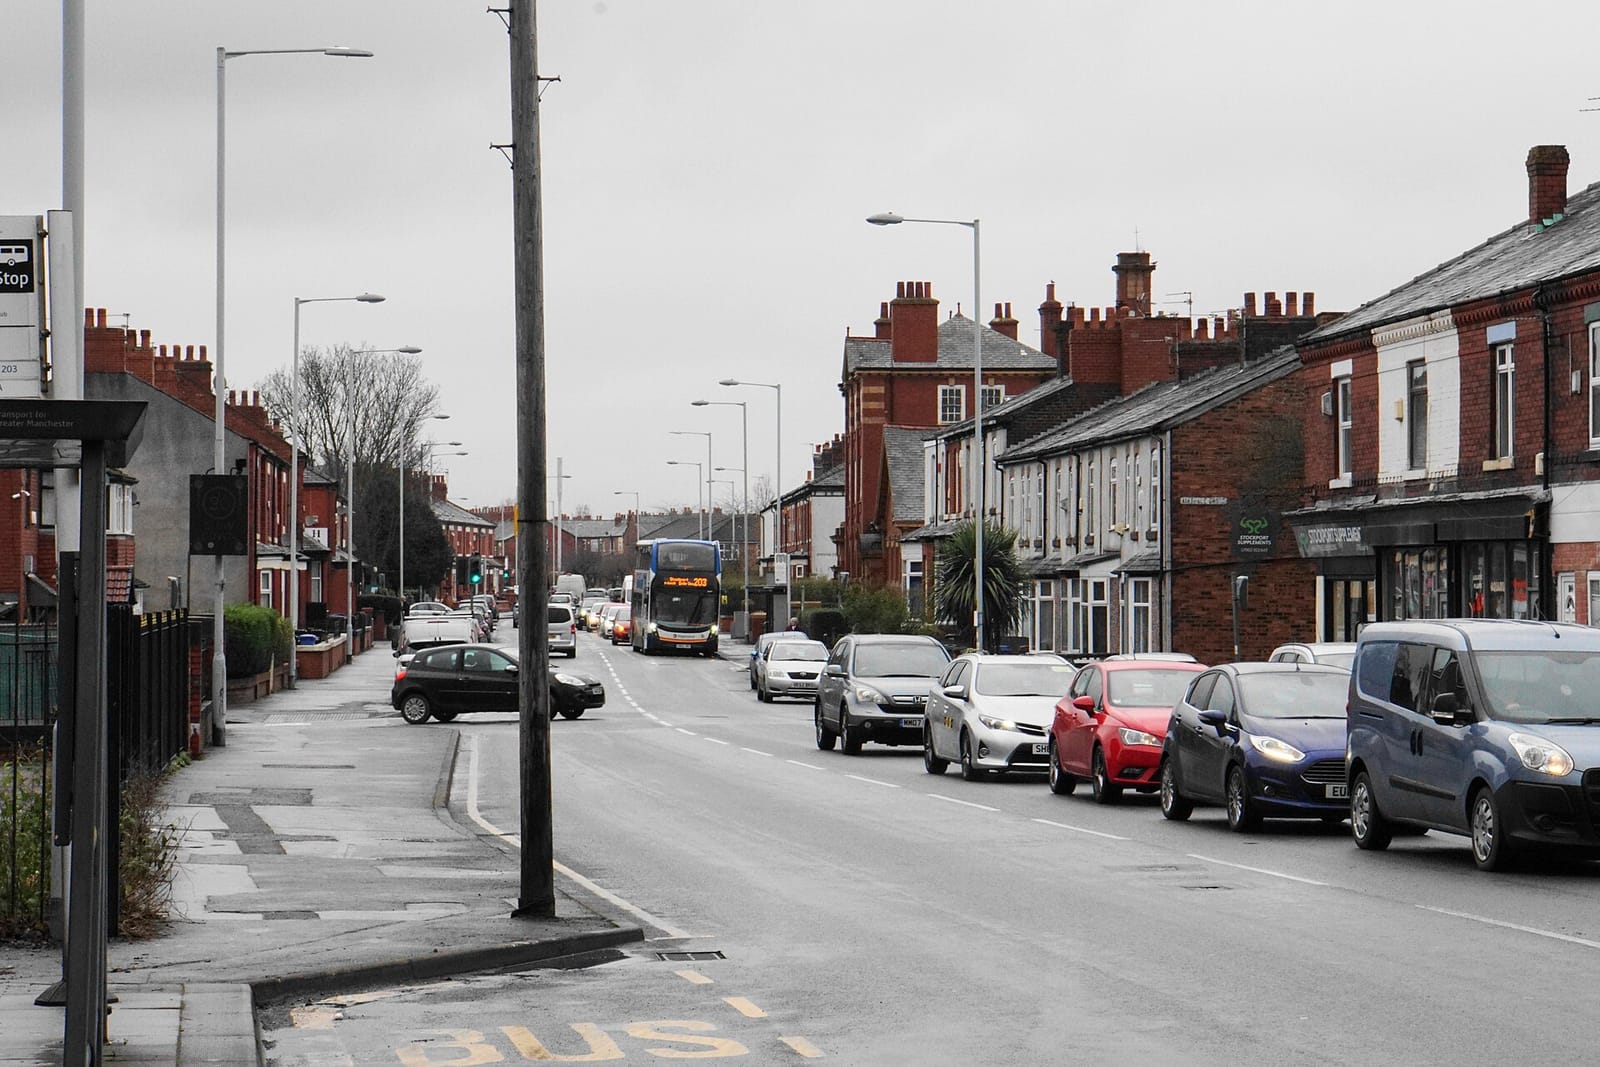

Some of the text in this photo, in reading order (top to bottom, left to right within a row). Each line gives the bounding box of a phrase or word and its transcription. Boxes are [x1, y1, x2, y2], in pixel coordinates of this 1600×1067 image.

[1, 365, 18, 373] 203
[0, 411, 33, 419] ansport
[26, 419, 73, 427] Manchester
[693, 577, 707, 587] 203
[394, 1020, 750, 1067] BUS
